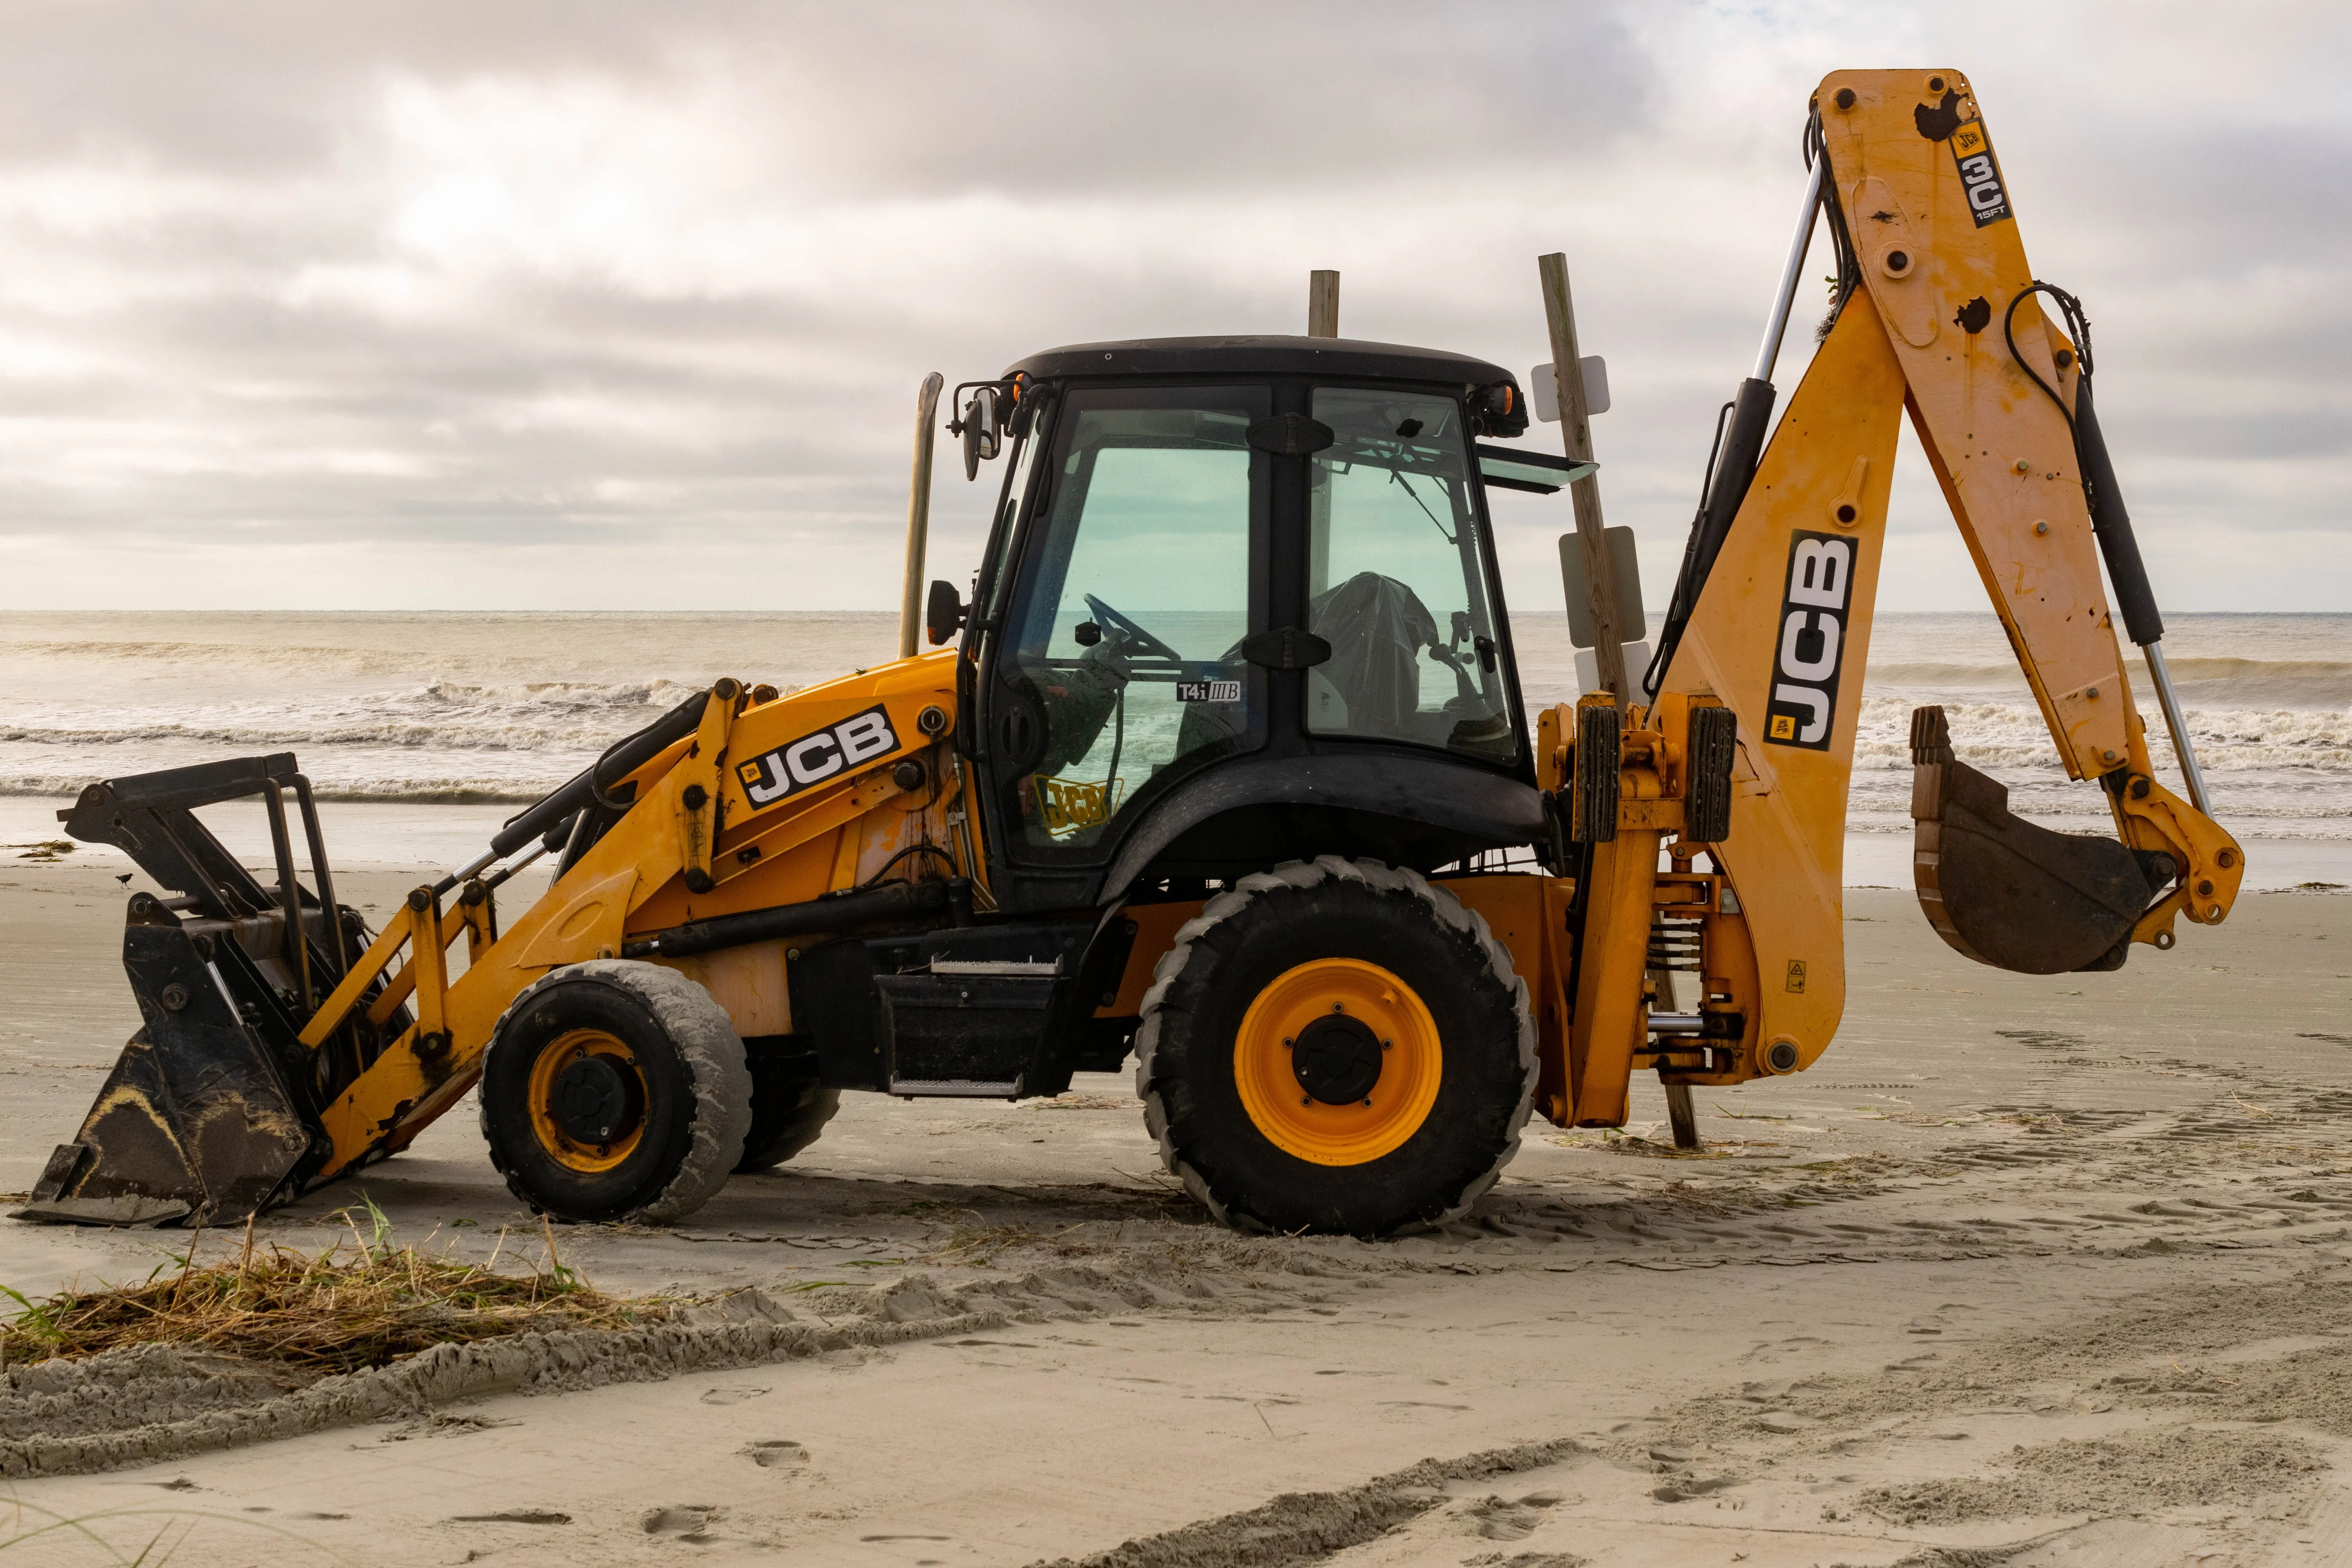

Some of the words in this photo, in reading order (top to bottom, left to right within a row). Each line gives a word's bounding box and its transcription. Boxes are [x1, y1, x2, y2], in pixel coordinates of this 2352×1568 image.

[1958, 132, 1979, 148] JCB
[1962, 155, 2002, 210] 3C
[1976, 205, 2005, 220] 15FT
[1775, 539, 1850, 742] JCB
[1179, 684, 1207, 699] T4i
[1210, 684, 1238, 699] IIIB
[1777, 720, 1788, 733] JCB
[749, 712, 894, 802] JCB
[1047, 782, 1103, 829] JCB
